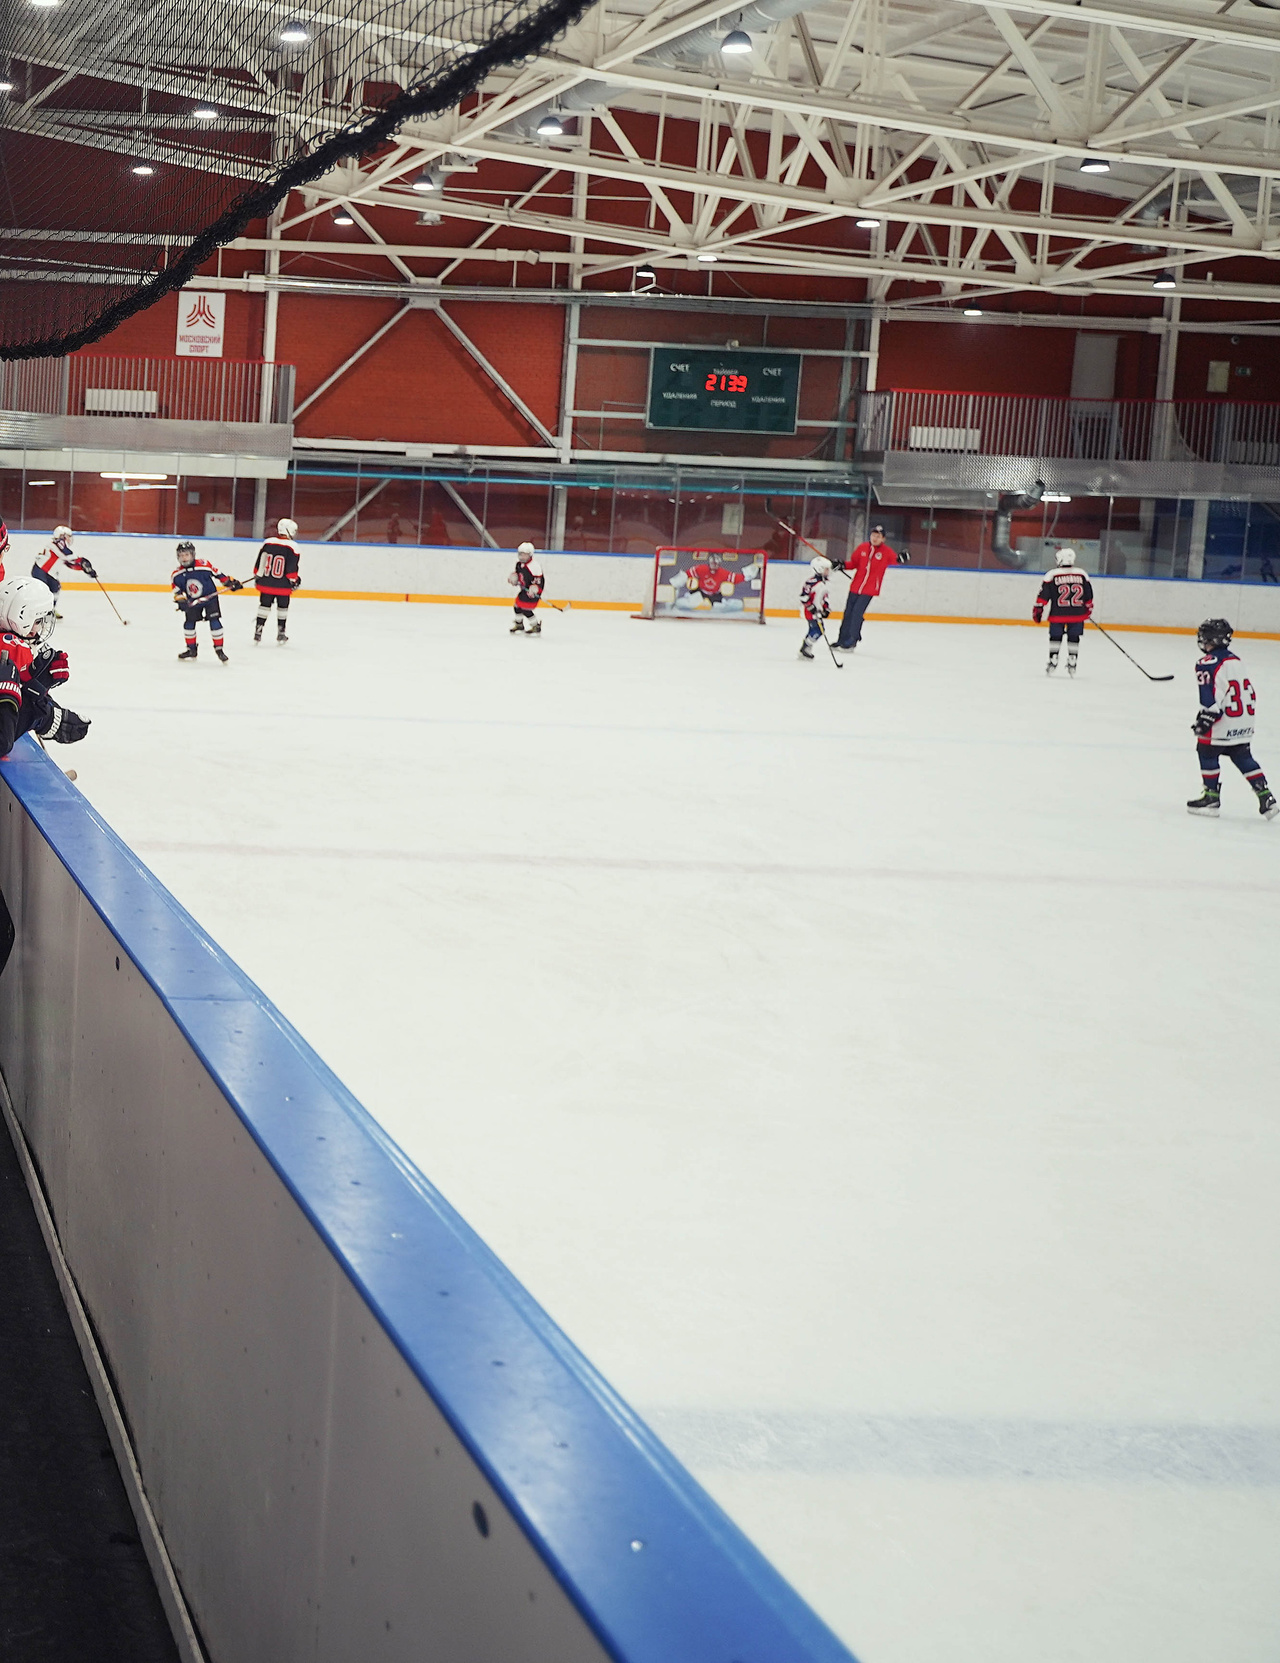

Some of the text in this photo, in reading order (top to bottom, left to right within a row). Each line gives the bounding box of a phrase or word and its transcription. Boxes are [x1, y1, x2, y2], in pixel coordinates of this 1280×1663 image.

[188, 344, 210, 354] СПОРТ
[669, 362, 691, 373] СЧЕТ
[762, 367, 783, 377] СЧЕТ
[1057, 584, 1084, 607] 22
[1225, 678, 1256, 718] 33
